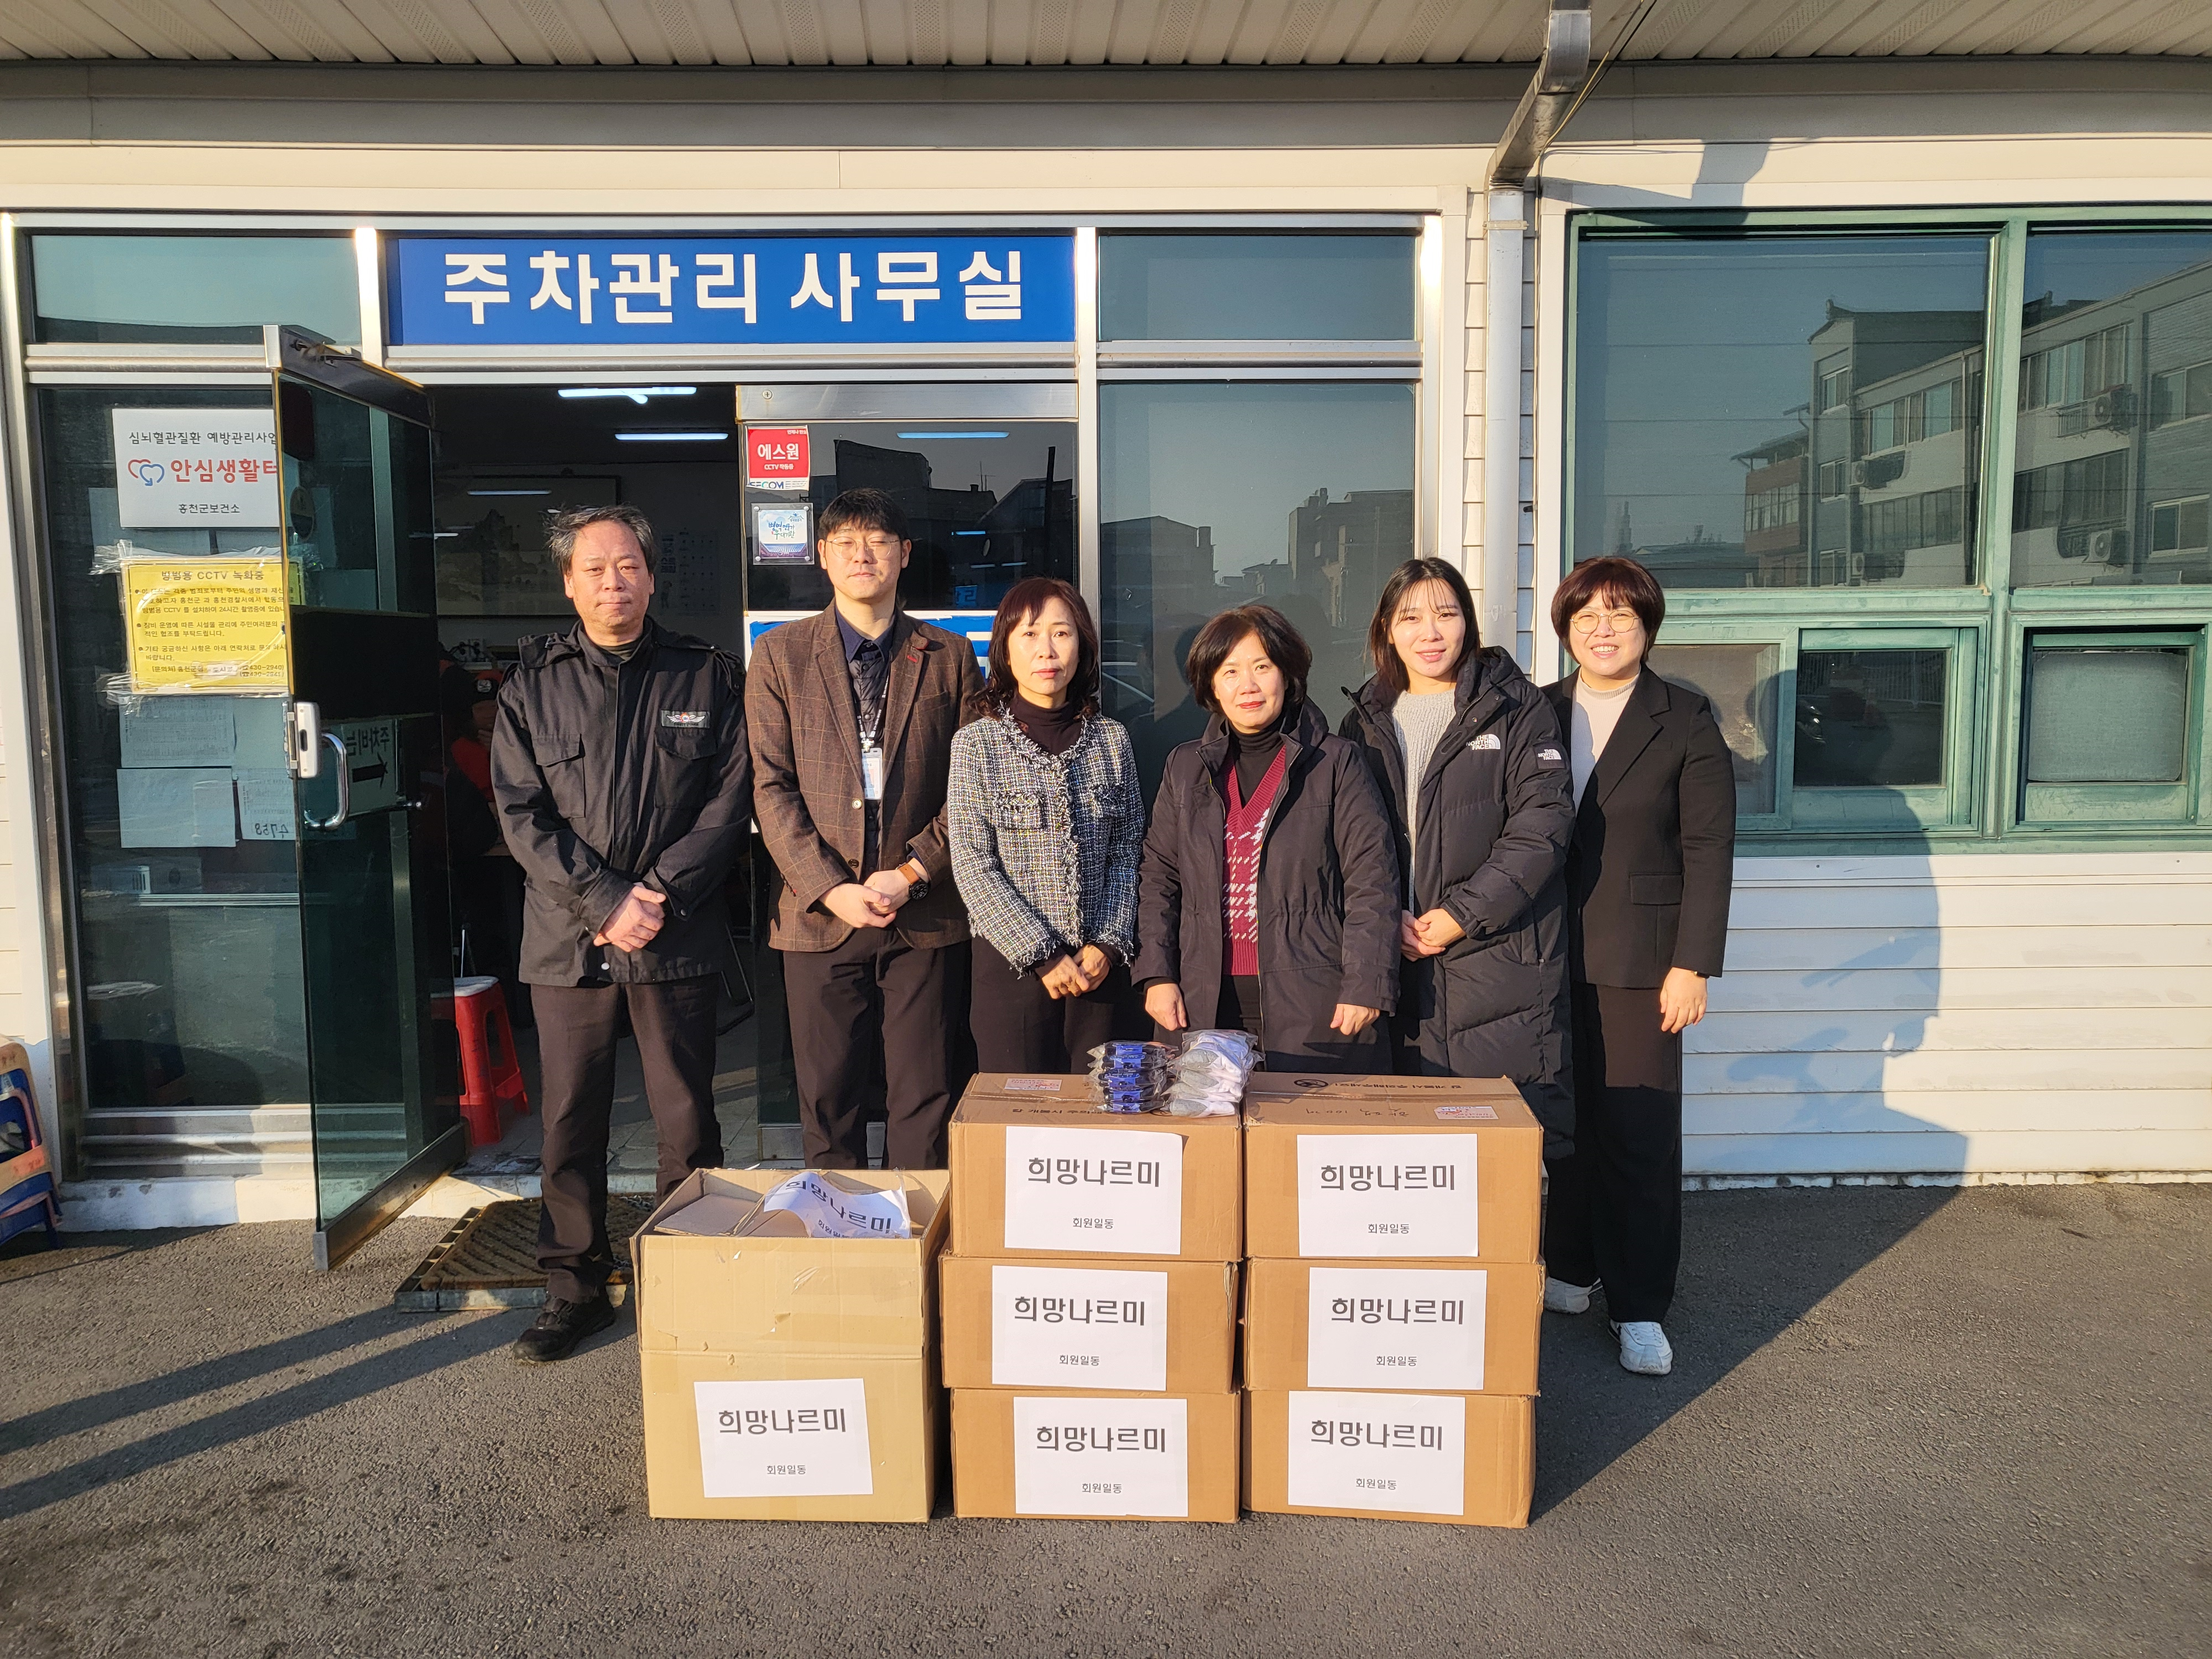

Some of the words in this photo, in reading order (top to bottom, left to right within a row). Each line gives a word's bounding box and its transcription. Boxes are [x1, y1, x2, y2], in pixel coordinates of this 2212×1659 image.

[445, 251, 757, 325] 주차관리
[791, 251, 1022, 322] 사무실
[128, 431, 201, 445] 심뇌혈관질환
[757, 443, 799, 460] 에스원
[178, 504, 240, 513] 홍천군보건소
[161, 571, 192, 581] 방범용
[197, 571, 227, 580] CCTV
[233, 570, 264, 581] 녹화중
[1027, 1157, 1160, 1187] 희망나르미
[1321, 1165, 1455, 1191] 희망나르미
[785, 1180, 891, 1234] 희망나르미
[1072, 1217, 1114, 1229] 회원일동
[1368, 1223, 1410, 1234] 회원일동
[1014, 1296, 1145, 1326] 희망나르미
[1331, 1297, 1464, 1325] 희망나르미
[1059, 1354, 1100, 1366] 회원일동
[1375, 1355, 1417, 1366] 회원일동
[718, 1408, 846, 1435] 희망나르미
[1036, 1426, 1166, 1453] 희망나르미
[1311, 1420, 1443, 1451] 희망나르미
[766, 1464, 806, 1475] 회원일동
[1082, 1483, 1123, 1494] 회원일동
[1355, 1478, 1397, 1491] 회원일동
